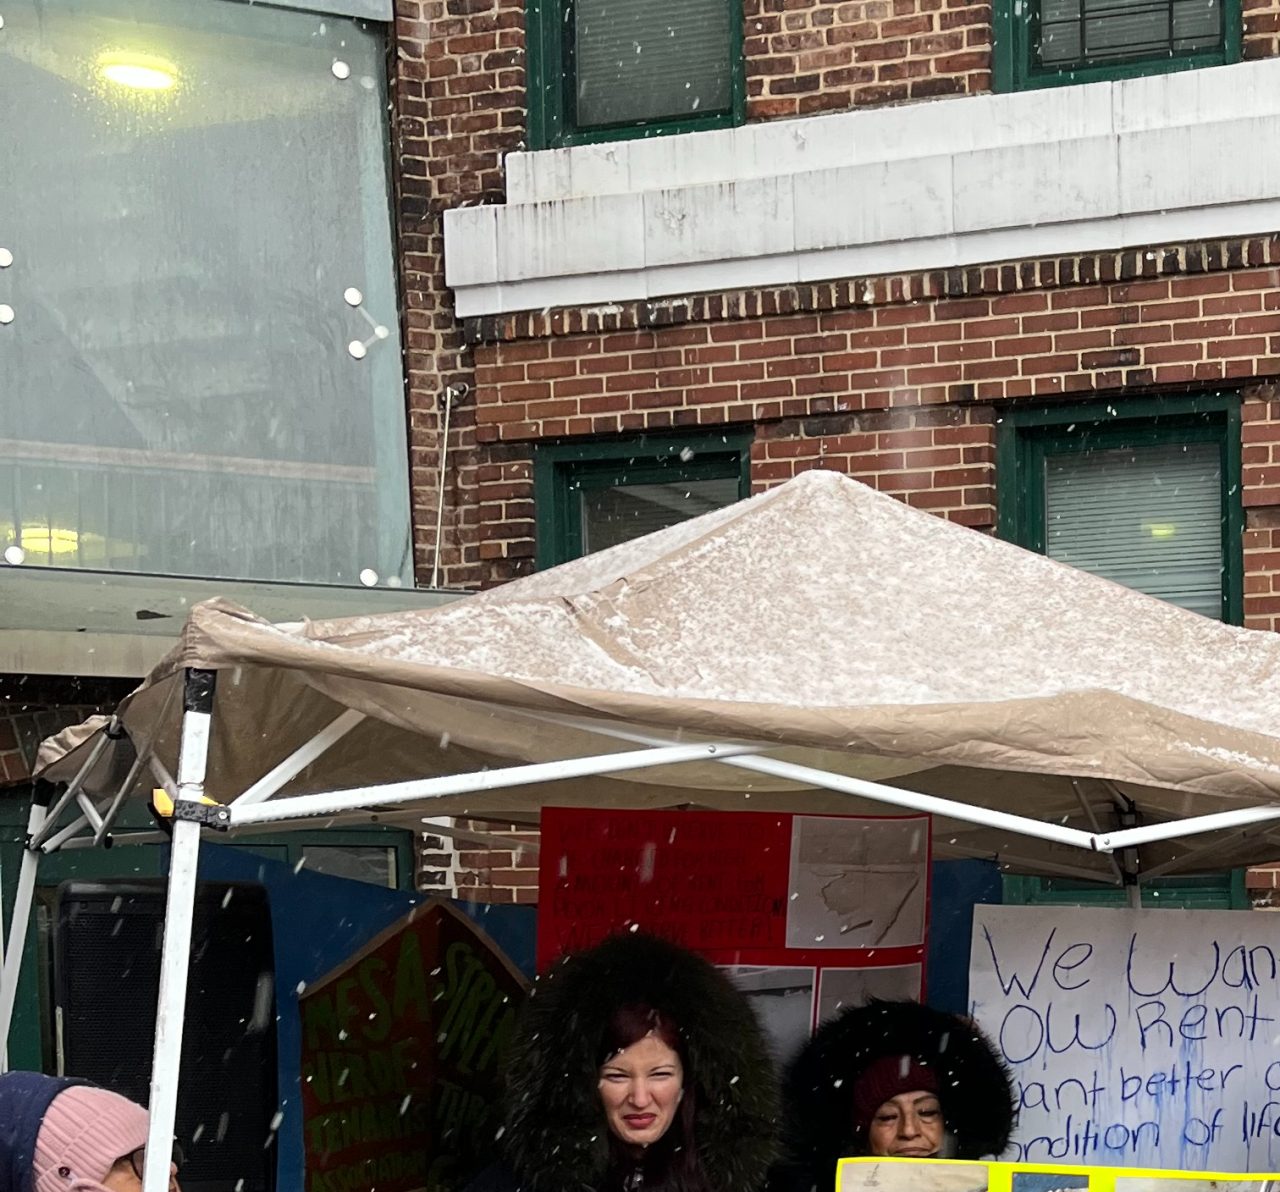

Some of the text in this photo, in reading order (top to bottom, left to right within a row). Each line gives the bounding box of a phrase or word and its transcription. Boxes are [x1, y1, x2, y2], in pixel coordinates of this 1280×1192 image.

[982, 923, 1094, 1000] We
[972, 998, 1117, 1064] OW
[1135, 993, 1275, 1053] Rent
[1119, 1060, 1243, 1103] better
[990, 1113, 1160, 1163] ondition
[1183, 1107, 1224, 1147] of
